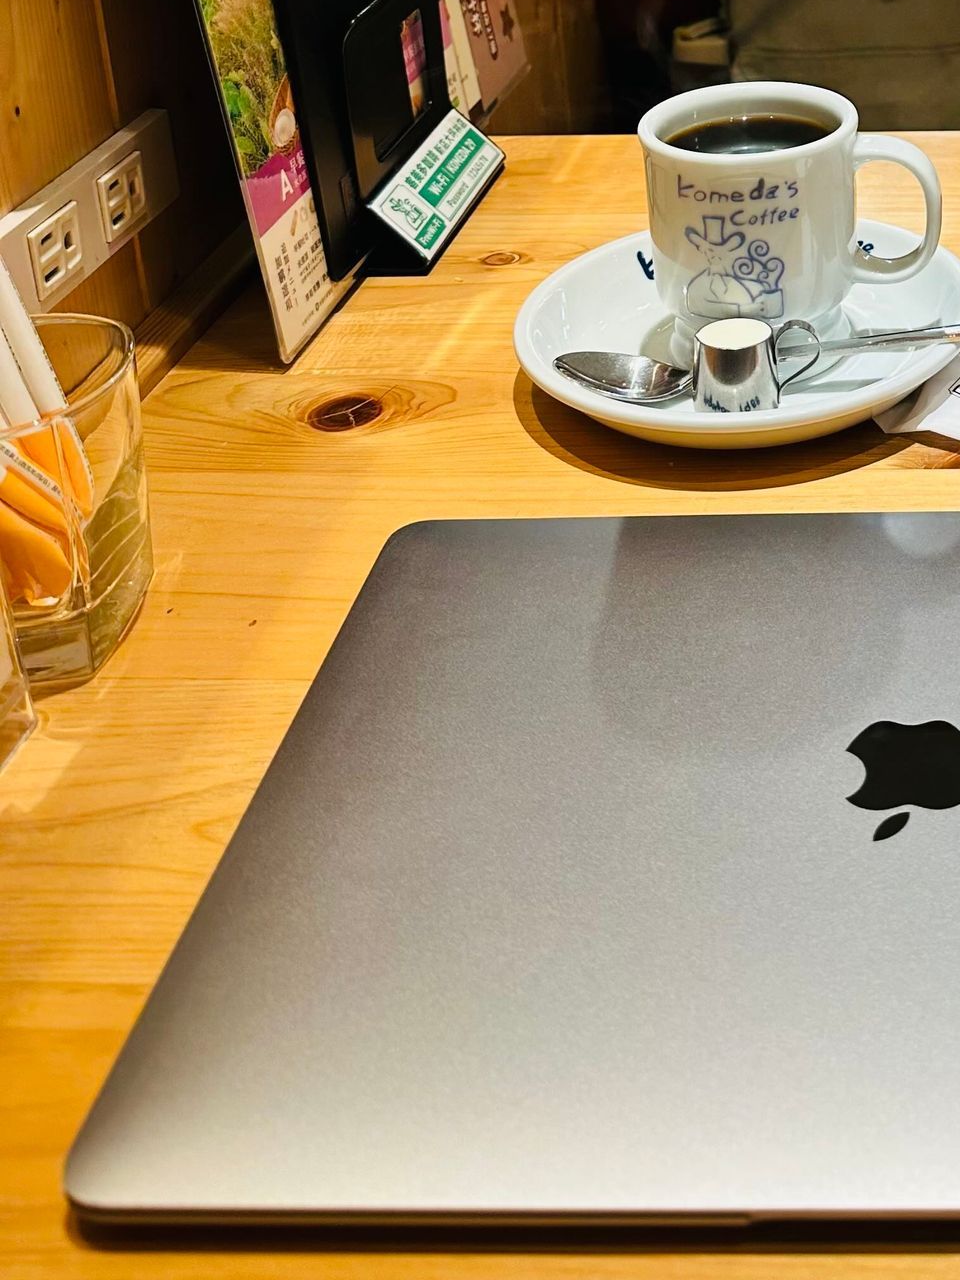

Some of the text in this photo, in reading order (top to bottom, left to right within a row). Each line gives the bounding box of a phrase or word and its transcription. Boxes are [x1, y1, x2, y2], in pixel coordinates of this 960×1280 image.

[405, 150, 440, 189] 客美多咖啡
[281, 168, 294, 202] A
[428, 173, 450, 196] Wi-Fi
[677, 175, 799, 203] Komeda's
[730, 206, 800, 227] Coffee
